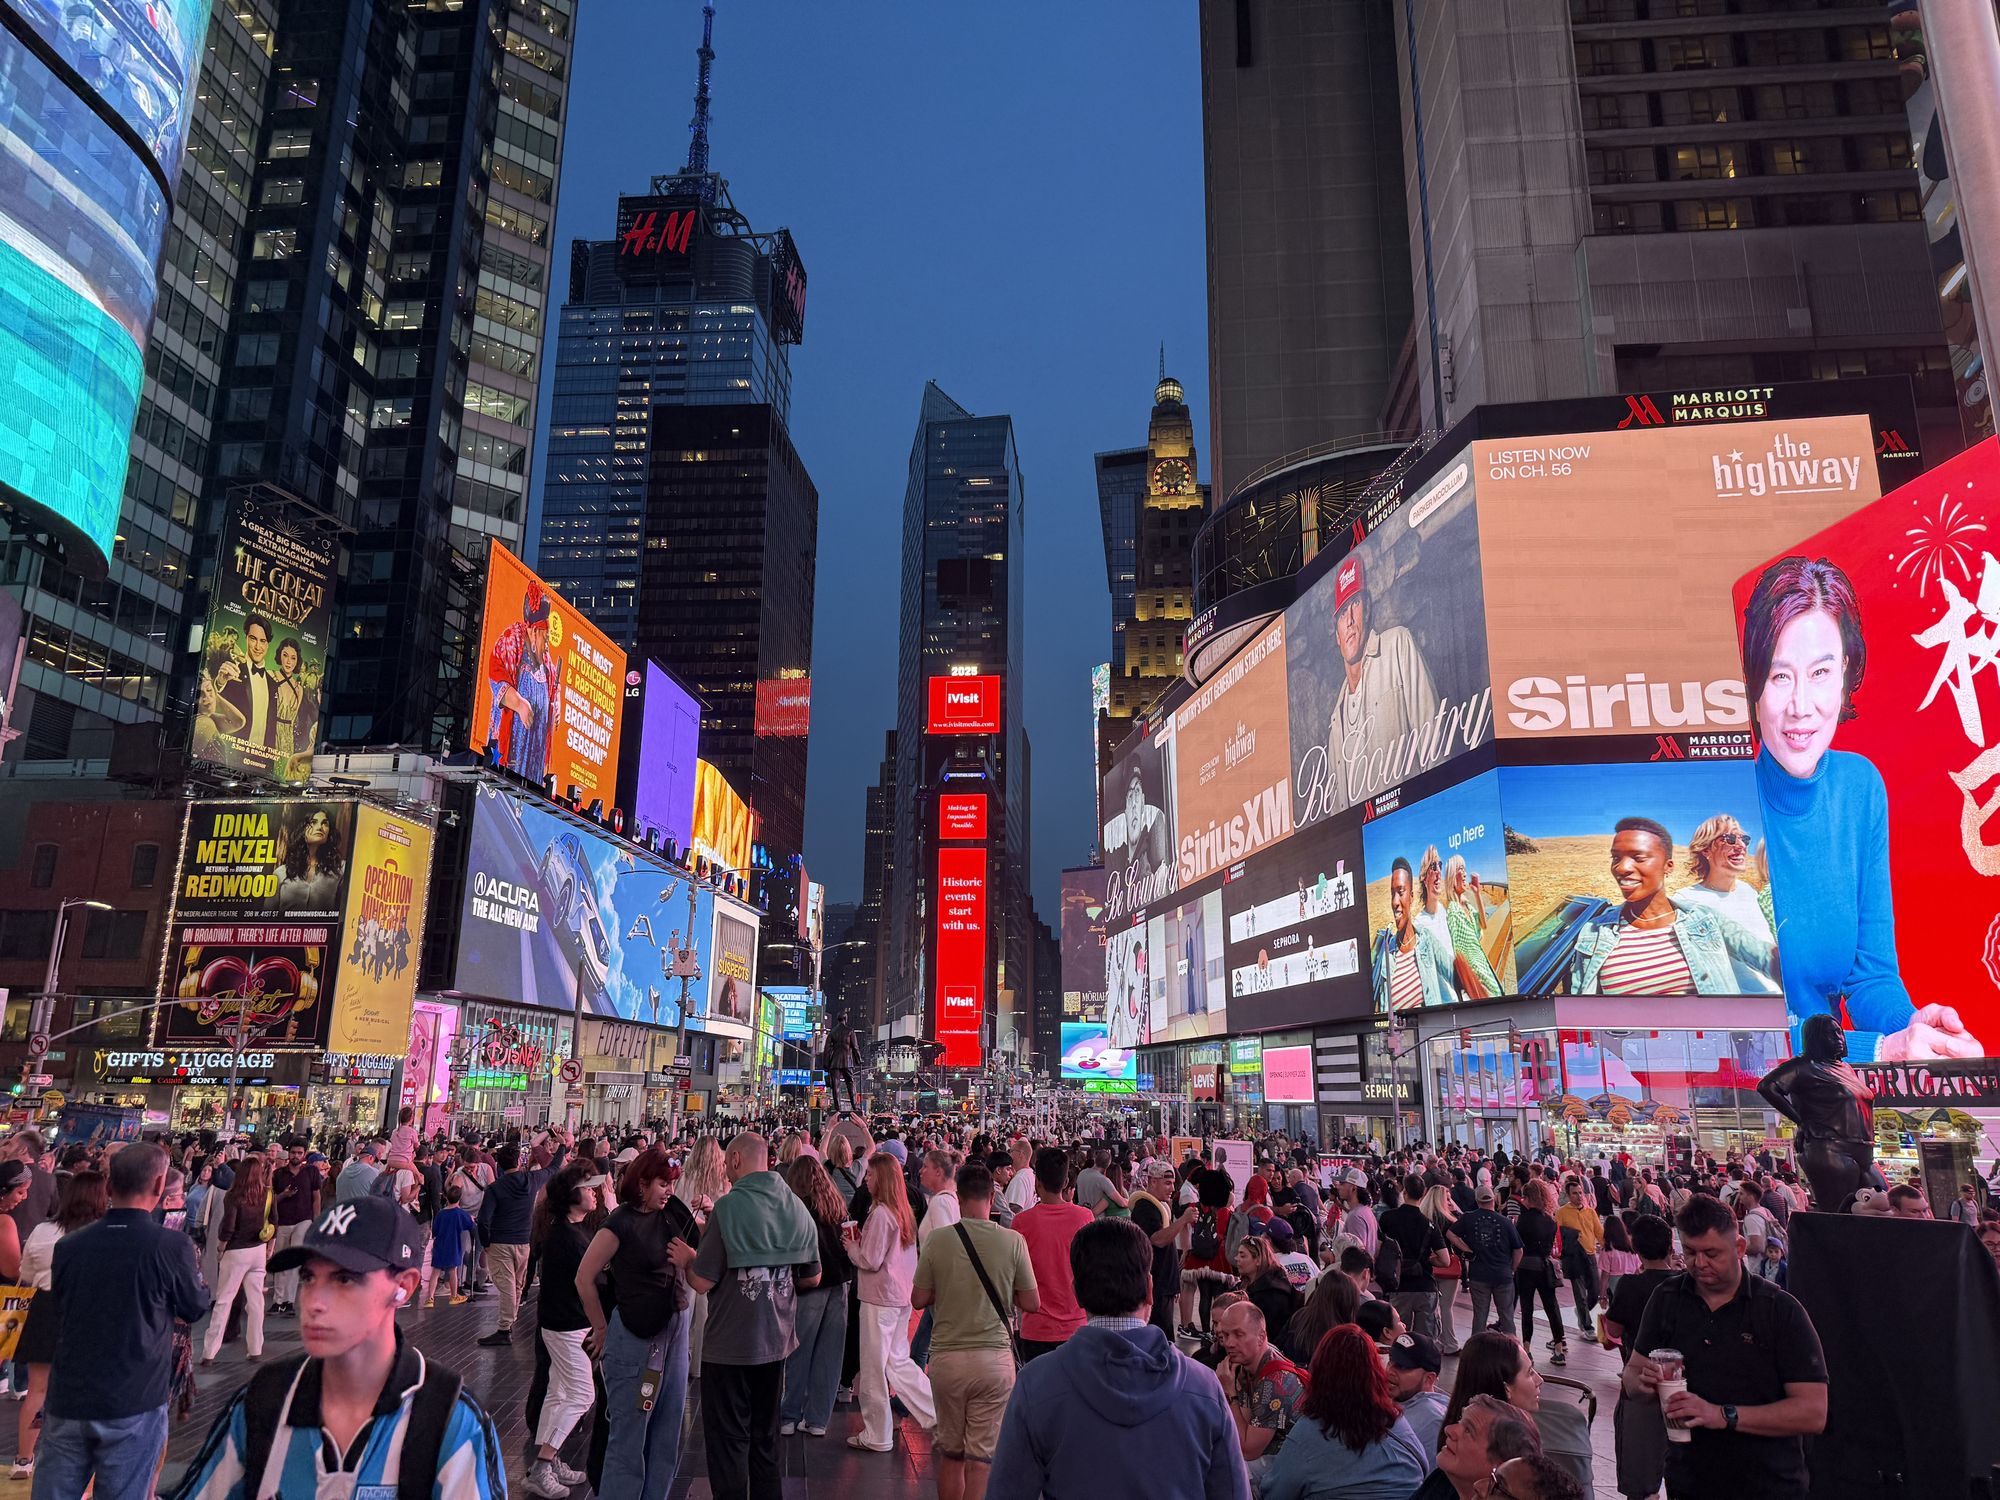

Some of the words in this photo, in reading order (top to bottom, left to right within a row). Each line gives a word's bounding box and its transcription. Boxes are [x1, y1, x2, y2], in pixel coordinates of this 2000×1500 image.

[620, 210, 696, 256] H&M
[1673, 388, 1774, 405] MARRIOTT
[1675, 404, 1764, 421] MARQUIS
[1489, 449, 1546, 466] LISTEN
[1549, 445, 1591, 460] NOW
[1774, 433, 1811, 459] the
[1882, 451, 1920, 459] MARRIOTT
[1490, 466, 1517, 480] ON
[1519, 463, 1549, 478] CH.
[1552, 462, 1572, 476] 56
[1712, 451, 1861, 497] highway
[1367, 479, 1404, 518] MARRIOTT
[1367, 497, 1401, 532] MARQUIS
[248, 521, 274, 541] GREAT,
[276, 535, 290, 547] BIG
[290, 542, 331, 566] BROADWAY
[258, 535, 315, 569] EXTRAVAGANZA
[235, 550, 267, 583] THE
[269, 567, 326, 608] GREAT
[242, 580, 313, 624] GATSBY
[257, 609, 273, 621] NEW
[272, 614, 299, 631] MUSICAL
[1187, 607, 1218, 635] MARRIOTT
[568, 649, 616, 698] INTOXICATING
[592, 649, 613, 677] MOST
[951, 666, 978, 677] 2025
[1214, 657, 1244, 701] GENERATION
[1244, 640, 1266, 674] STARTS
[1266, 625, 1282, 656] HERE
[566, 668, 573, 685] &
[574, 673, 615, 716] RAPTUROUS
[625, 688, 640, 697] LG
[948, 693, 979, 704] iVisit
[1507, 672, 1750, 731] Sirius
[565, 686, 592, 716] MUSICAL
[593, 706, 602, 721] OF
[602, 713, 614, 731] THE
[564, 703, 611, 750] BROADWAY
[1237, 720, 1245, 737] the
[237, 737, 268, 752] BROADWAY
[250, 749, 281, 762] BROADWAY
[1225, 729, 1256, 767] highway
[1690, 746, 1753, 756] MARQUIS
[1293, 745, 1339, 829] Be
[1342, 687, 1492, 802] Country
[1375, 788, 1401, 806] MARRIOTT
[1376, 799, 1399, 815] MARQUIS
[212, 813, 269, 838] IDINA
[1181, 778, 1290, 883] SiriusXM
[1449, 832, 1462, 849] up
[1462, 823, 1485, 844] here
[196, 839, 278, 864] MENZEL
[204, 865, 229, 873] RETURNS
[235, 865, 264, 873] BROADWAY
[185, 874, 279, 898] REDWOOD
[364, 864, 413, 905] OPERATION
[943, 877, 982, 887] Historic
[1104, 870, 1123, 923] Be
[1125, 859, 1178, 913] Country
[485, 878, 540, 912] ACURA
[945, 893, 976, 901] events
[183, 910, 218, 918] NEDERLANDER
[218, 910, 239, 918] THEATRE
[243, 910, 254, 918] 208
[284, 910, 340, 918] REDWOODMUSICAL.COM
[473, 898, 488, 920] THE
[522, 913, 540, 933] ADX
[948, 907, 972, 915] start
[182, 928, 193, 942] ON
[193, 928, 235, 943] BROADWAY,
[236, 928, 265, 943] THERE'S
[265, 928, 279, 942] LIFE
[279, 928, 302, 942] AFTER
[302, 928, 327, 942] ROMEO
[943, 921, 964, 930] with
[967, 922, 980, 930] us.
[1273, 933, 1300, 951] SEPHORA
[718, 959, 749, 981] SUSPECTS
[946, 997, 974, 1007] iVisit
[596, 1022, 650, 1058] FOREVER
[107, 1052, 165, 1067] GIFTS
[180, 1053, 275, 1068] LUGGAGE
[355, 1054, 396, 1070] LUGGAGE
[188, 1068, 204, 1076] NY
[606, 1085, 628, 1098] FOREVER
